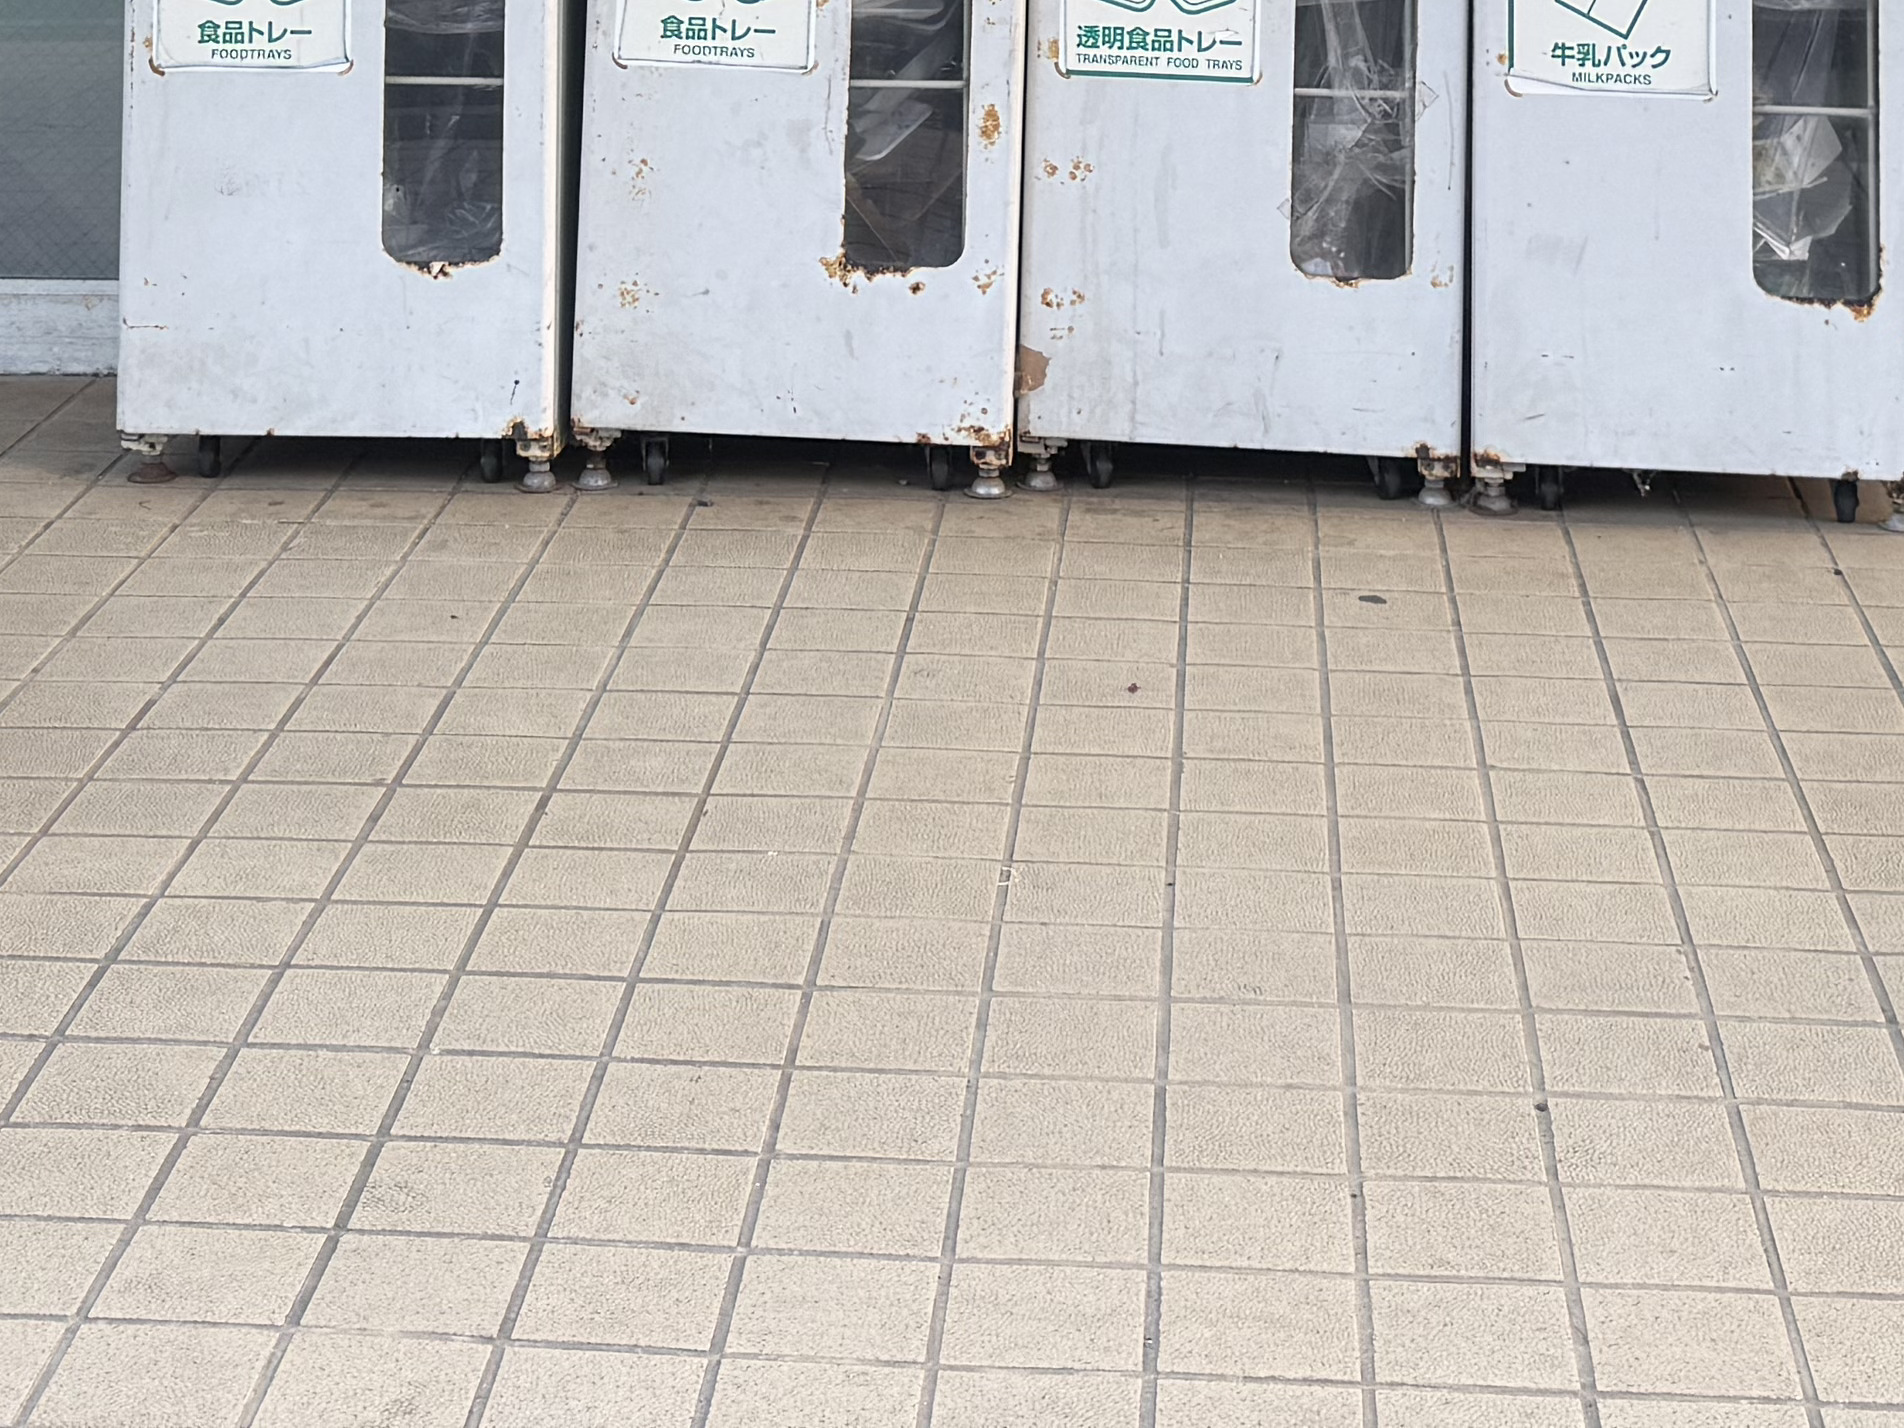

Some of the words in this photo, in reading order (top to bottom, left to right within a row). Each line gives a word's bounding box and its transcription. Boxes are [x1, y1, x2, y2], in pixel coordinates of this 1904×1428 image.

[197, 19, 313, 44] 食品トレー
[660, 15, 776, 41] 食品トレー
[1076, 25, 1243, 53] 透明食品トレー
[211, 48, 292, 60] FOODTRAYS
[673, 44, 756, 58] FOODTRAYS
[1551, 42, 1672, 69] 牛乳パック
[1076, 53, 1161, 67] TRANSPARENT
[1166, 57, 1199, 69] FOOD
[1206, 59, 1243, 71] TRAYS
[1572, 72, 1652, 85] MILKPACKS
